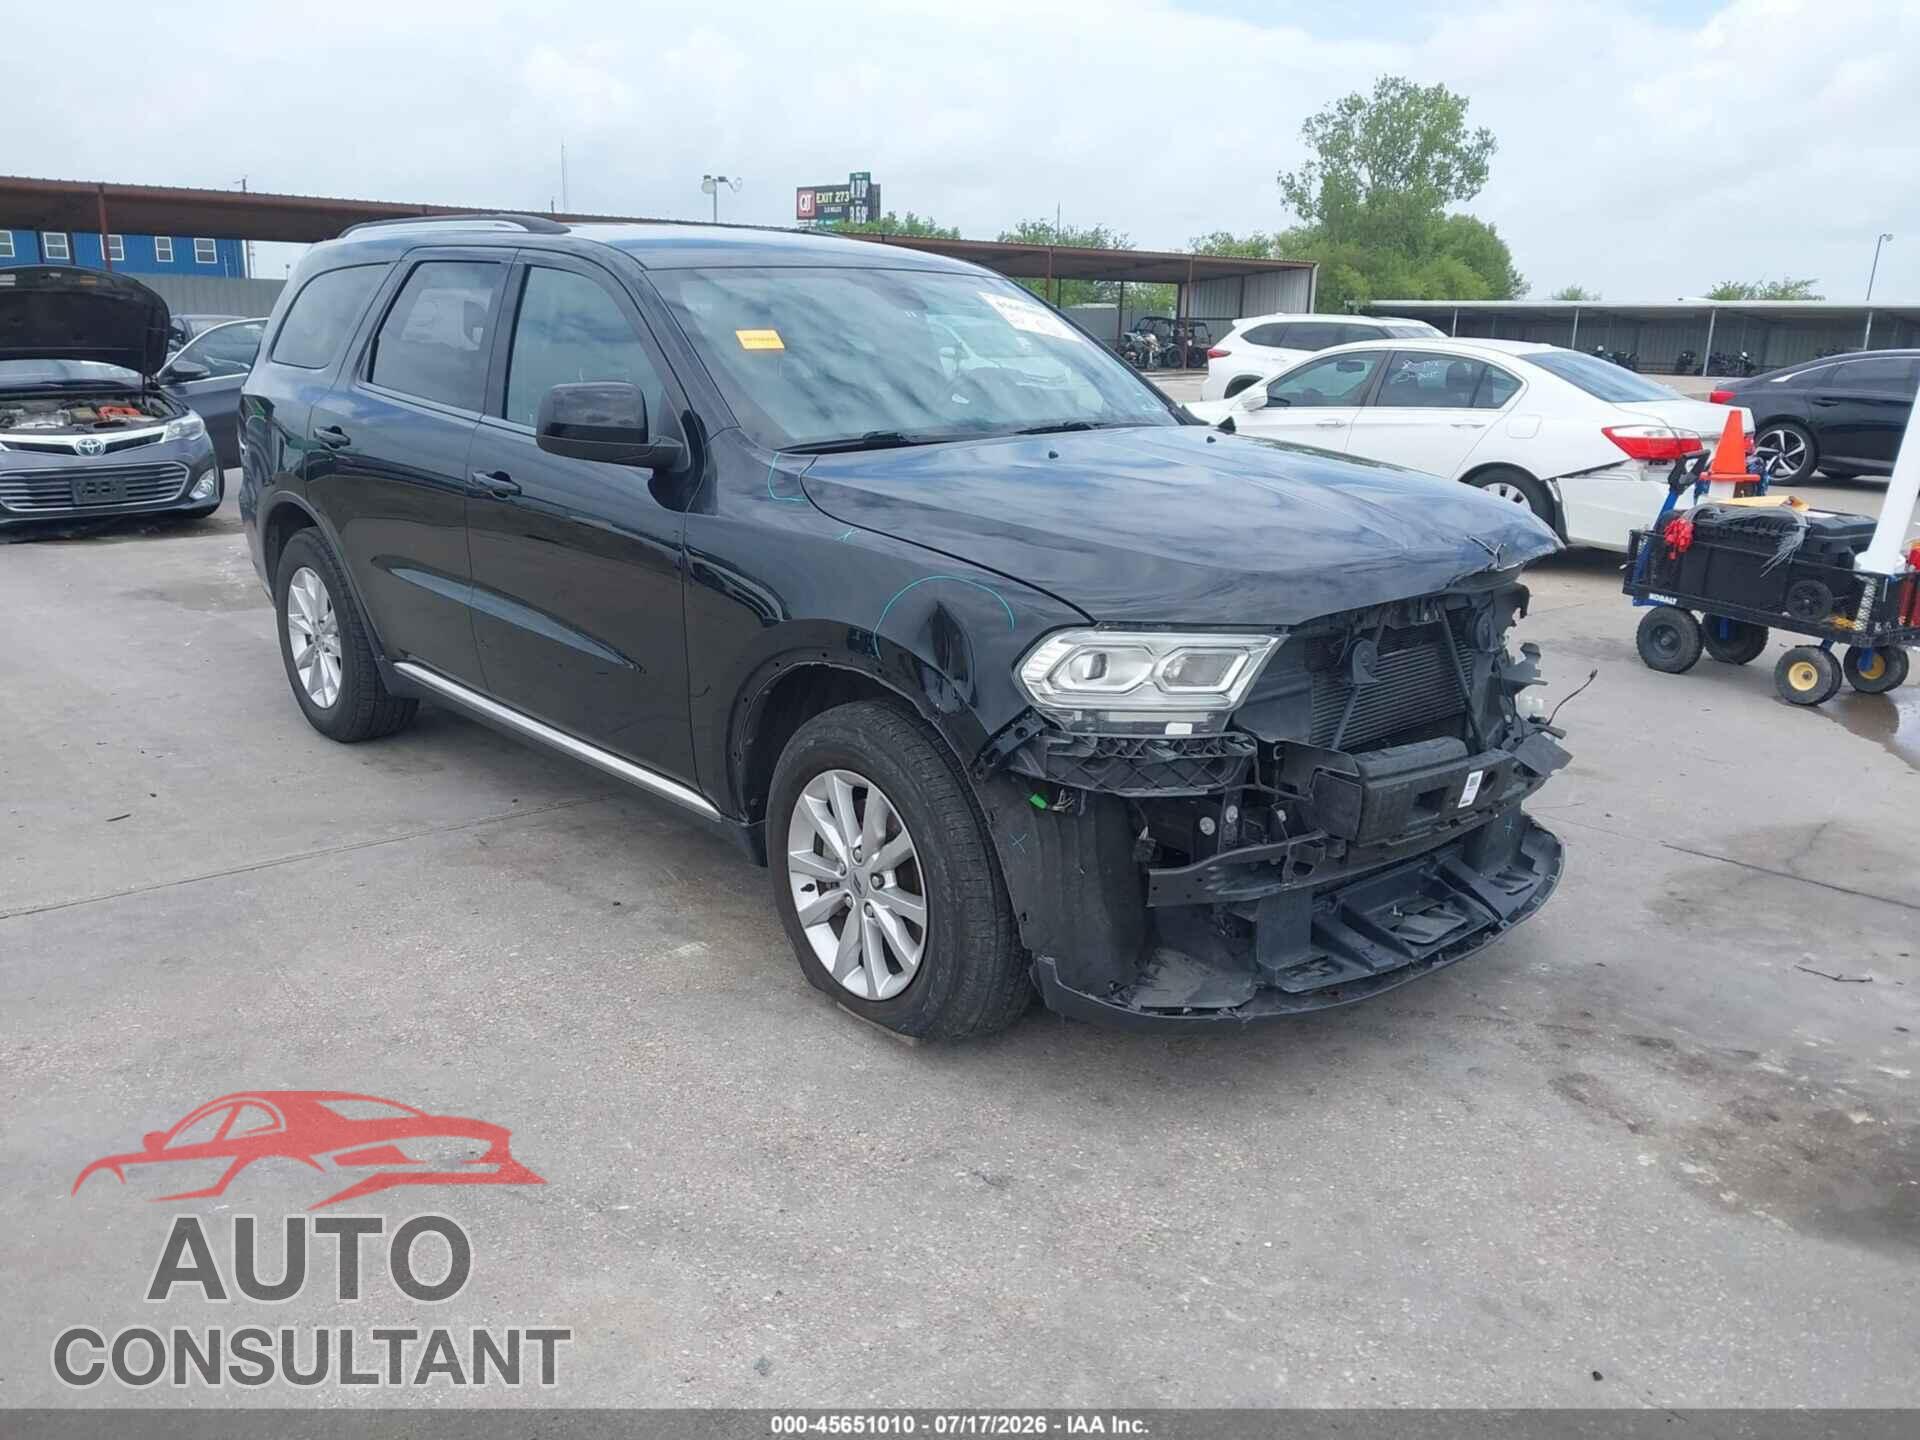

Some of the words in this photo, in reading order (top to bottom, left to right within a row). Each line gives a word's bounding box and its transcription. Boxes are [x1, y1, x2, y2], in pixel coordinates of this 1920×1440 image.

[800, 194, 812, 211] QT
[816, 192, 833, 203] EXIT
[834, 191, 850, 202] 273
